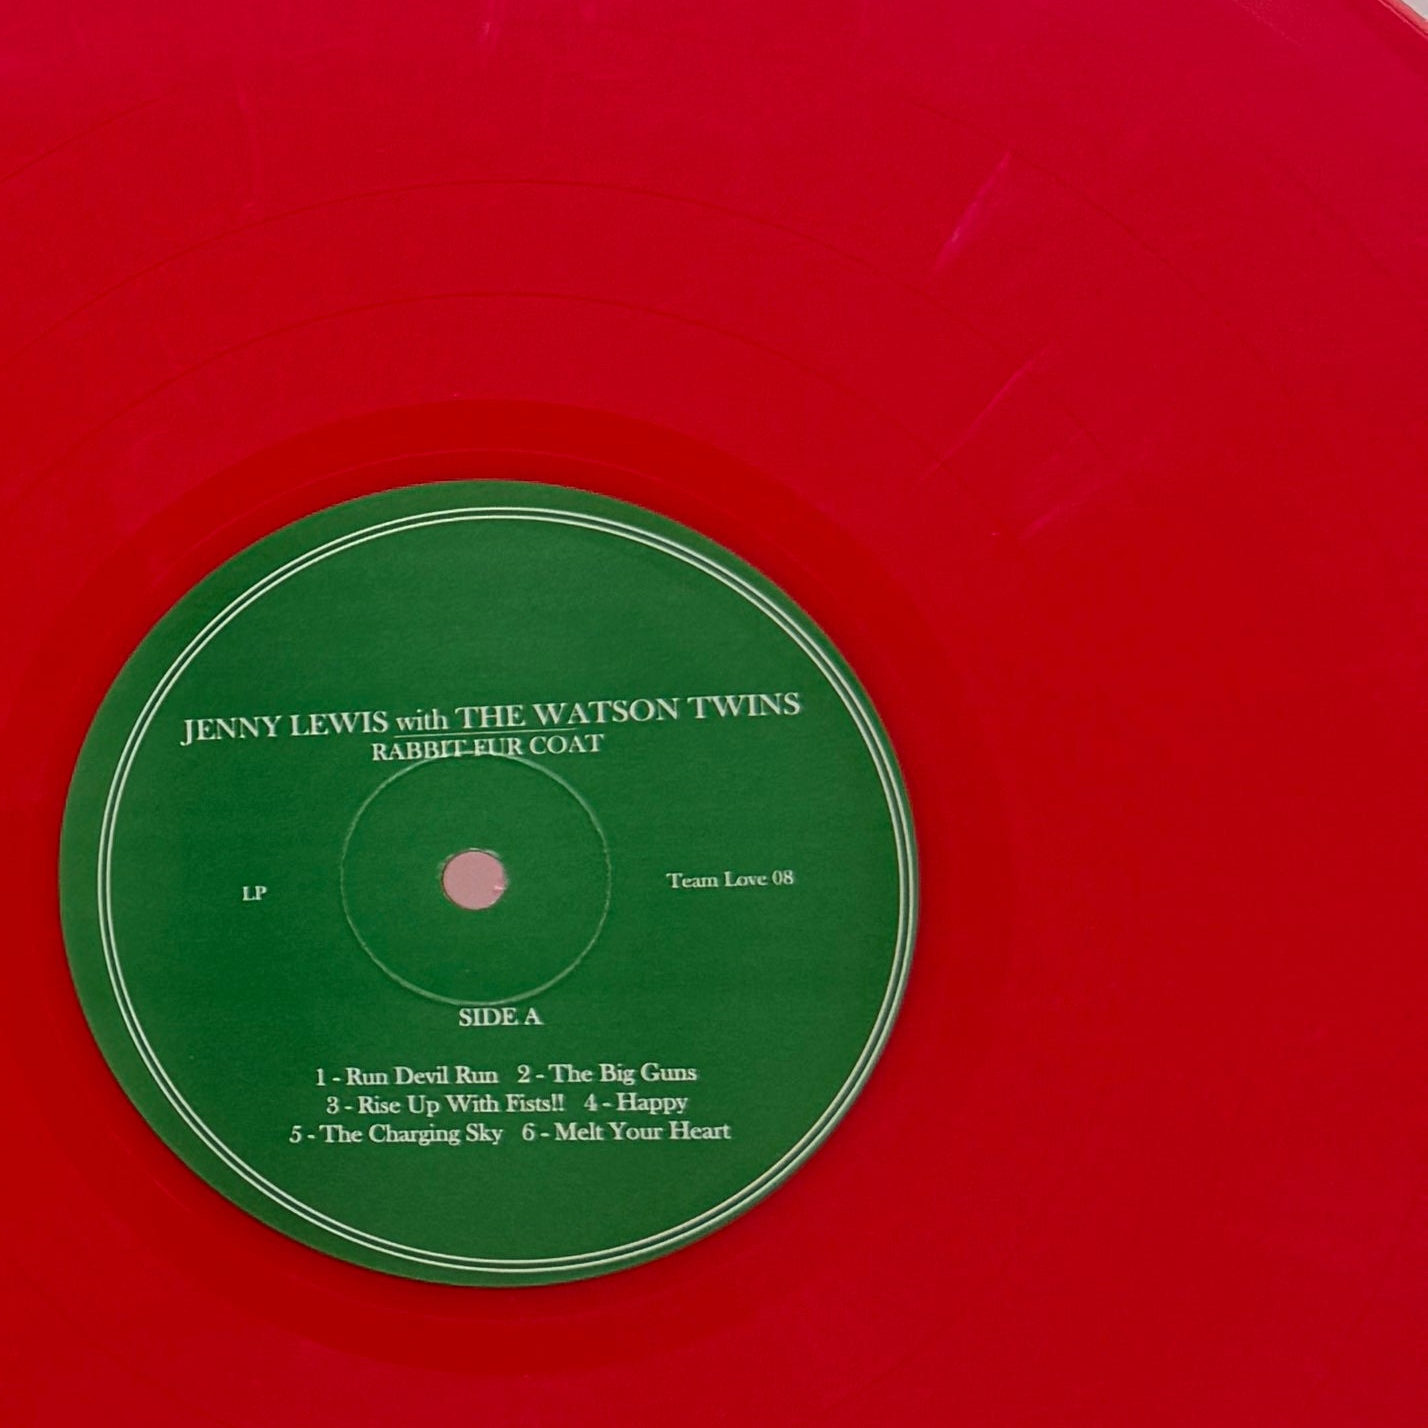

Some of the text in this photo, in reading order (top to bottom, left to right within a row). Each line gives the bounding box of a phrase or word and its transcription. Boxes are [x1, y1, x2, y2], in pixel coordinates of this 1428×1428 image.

[180, 692, 801, 747] JENNY LEWIS with THE WATSON TWINS
[371, 733, 604, 761] RABBIT FUR COAT
[665, 869, 794, 889] Team Love 08
[241, 884, 267, 902] LP
[458, 1006, 544, 1027] SIDE A
[315, 1068, 326, 1086] 1
[345, 1066, 389, 1086] Run
[394, 1064, 450, 1085] Devil
[455, 1065, 499, 1085] Run
[517, 1064, 531, 1084] 2
[548, 1063, 593, 1083] The
[598, 1062, 636, 1086] Big
[640, 1062, 698, 1082] Guns
[326, 1096, 340, 1115] 3
[357, 1094, 401, 1114] Rise
[406, 1094, 440, 1118] Up
[445, 1093, 500, 1113] With
[505, 1093, 565, 1113] Fists!!
[584, 1092, 598, 1112] 4
[616, 1091, 689, 1116] Happy
[289, 1125, 302, 1144] 5
[318, 1123, 363, 1143] The
[368, 1122, 461, 1147] Charging
[465, 1122, 504, 1146] Sky
[521, 1122, 536, 1142] 6
[554, 1121, 604, 1141] Melt
[607, 1121, 664, 1141] Your
[669, 1120, 732, 1140] Heart
